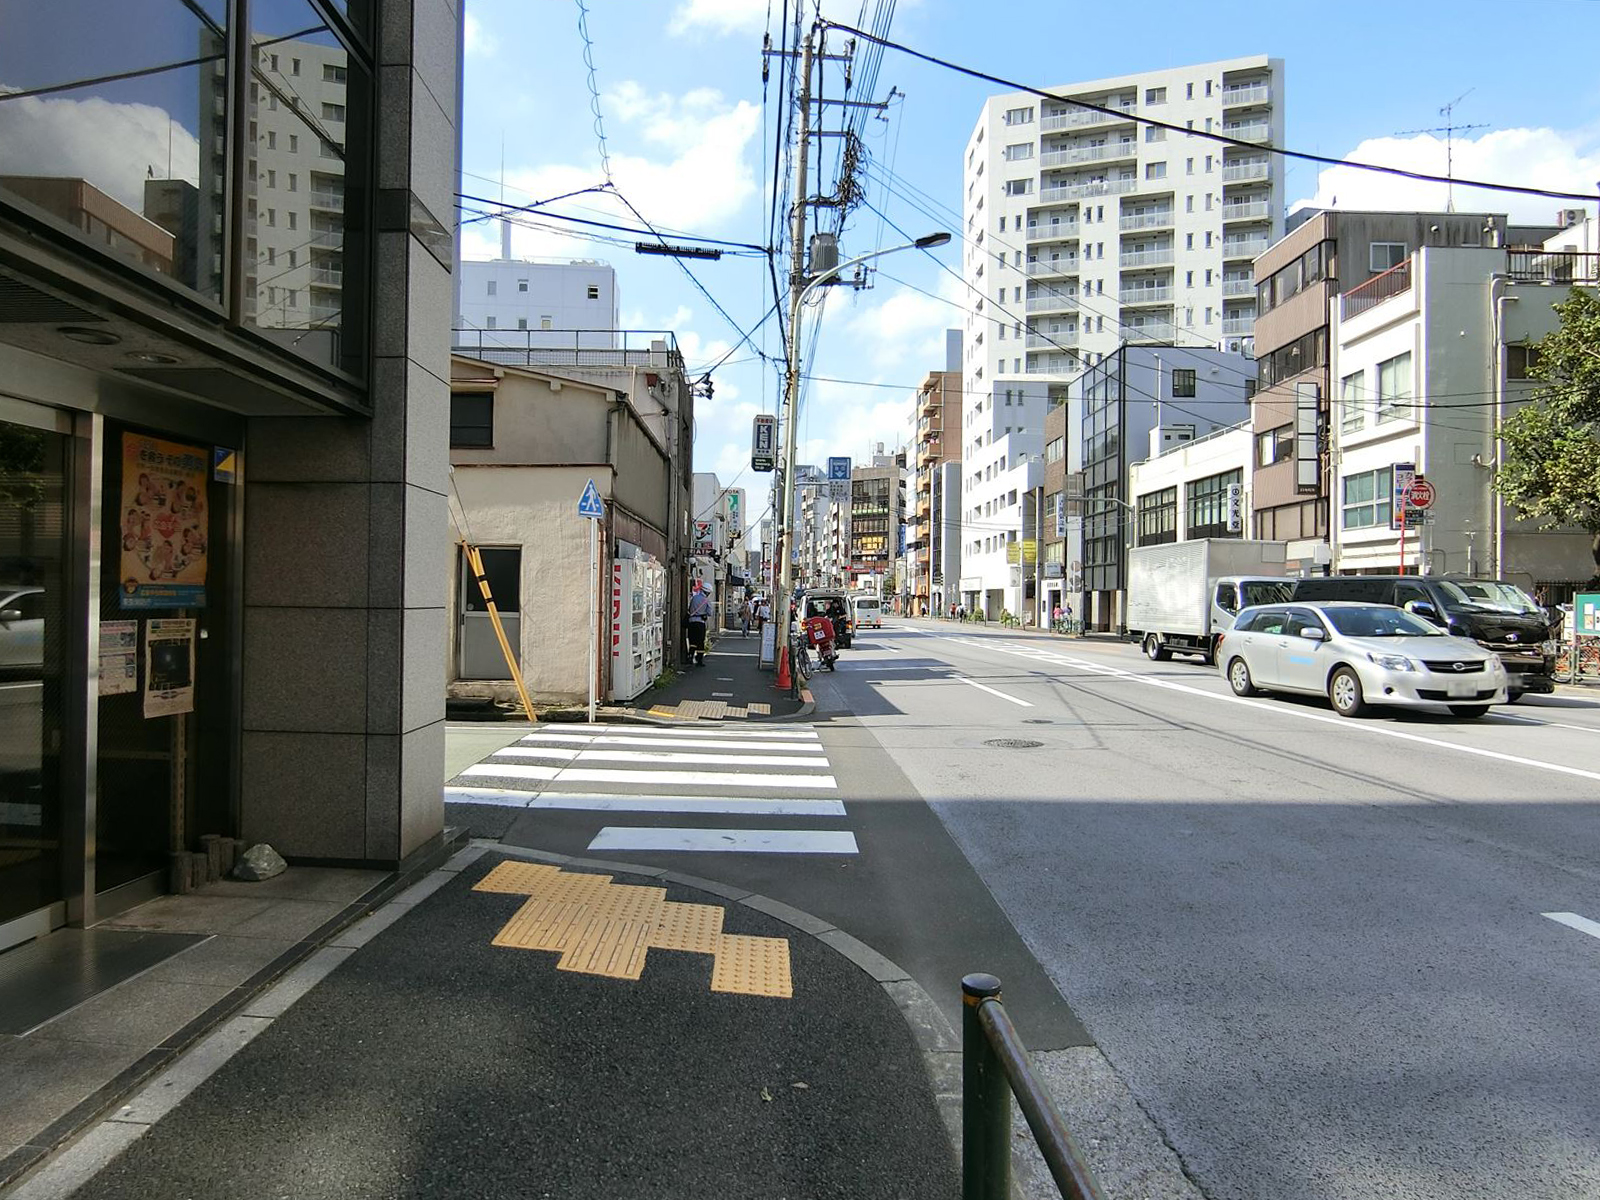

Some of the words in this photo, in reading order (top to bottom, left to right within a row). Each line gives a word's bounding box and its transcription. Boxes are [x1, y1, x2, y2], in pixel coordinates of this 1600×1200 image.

[760, 425, 769, 449] KEN
[1411, 490, 1430, 501] 消火栓
